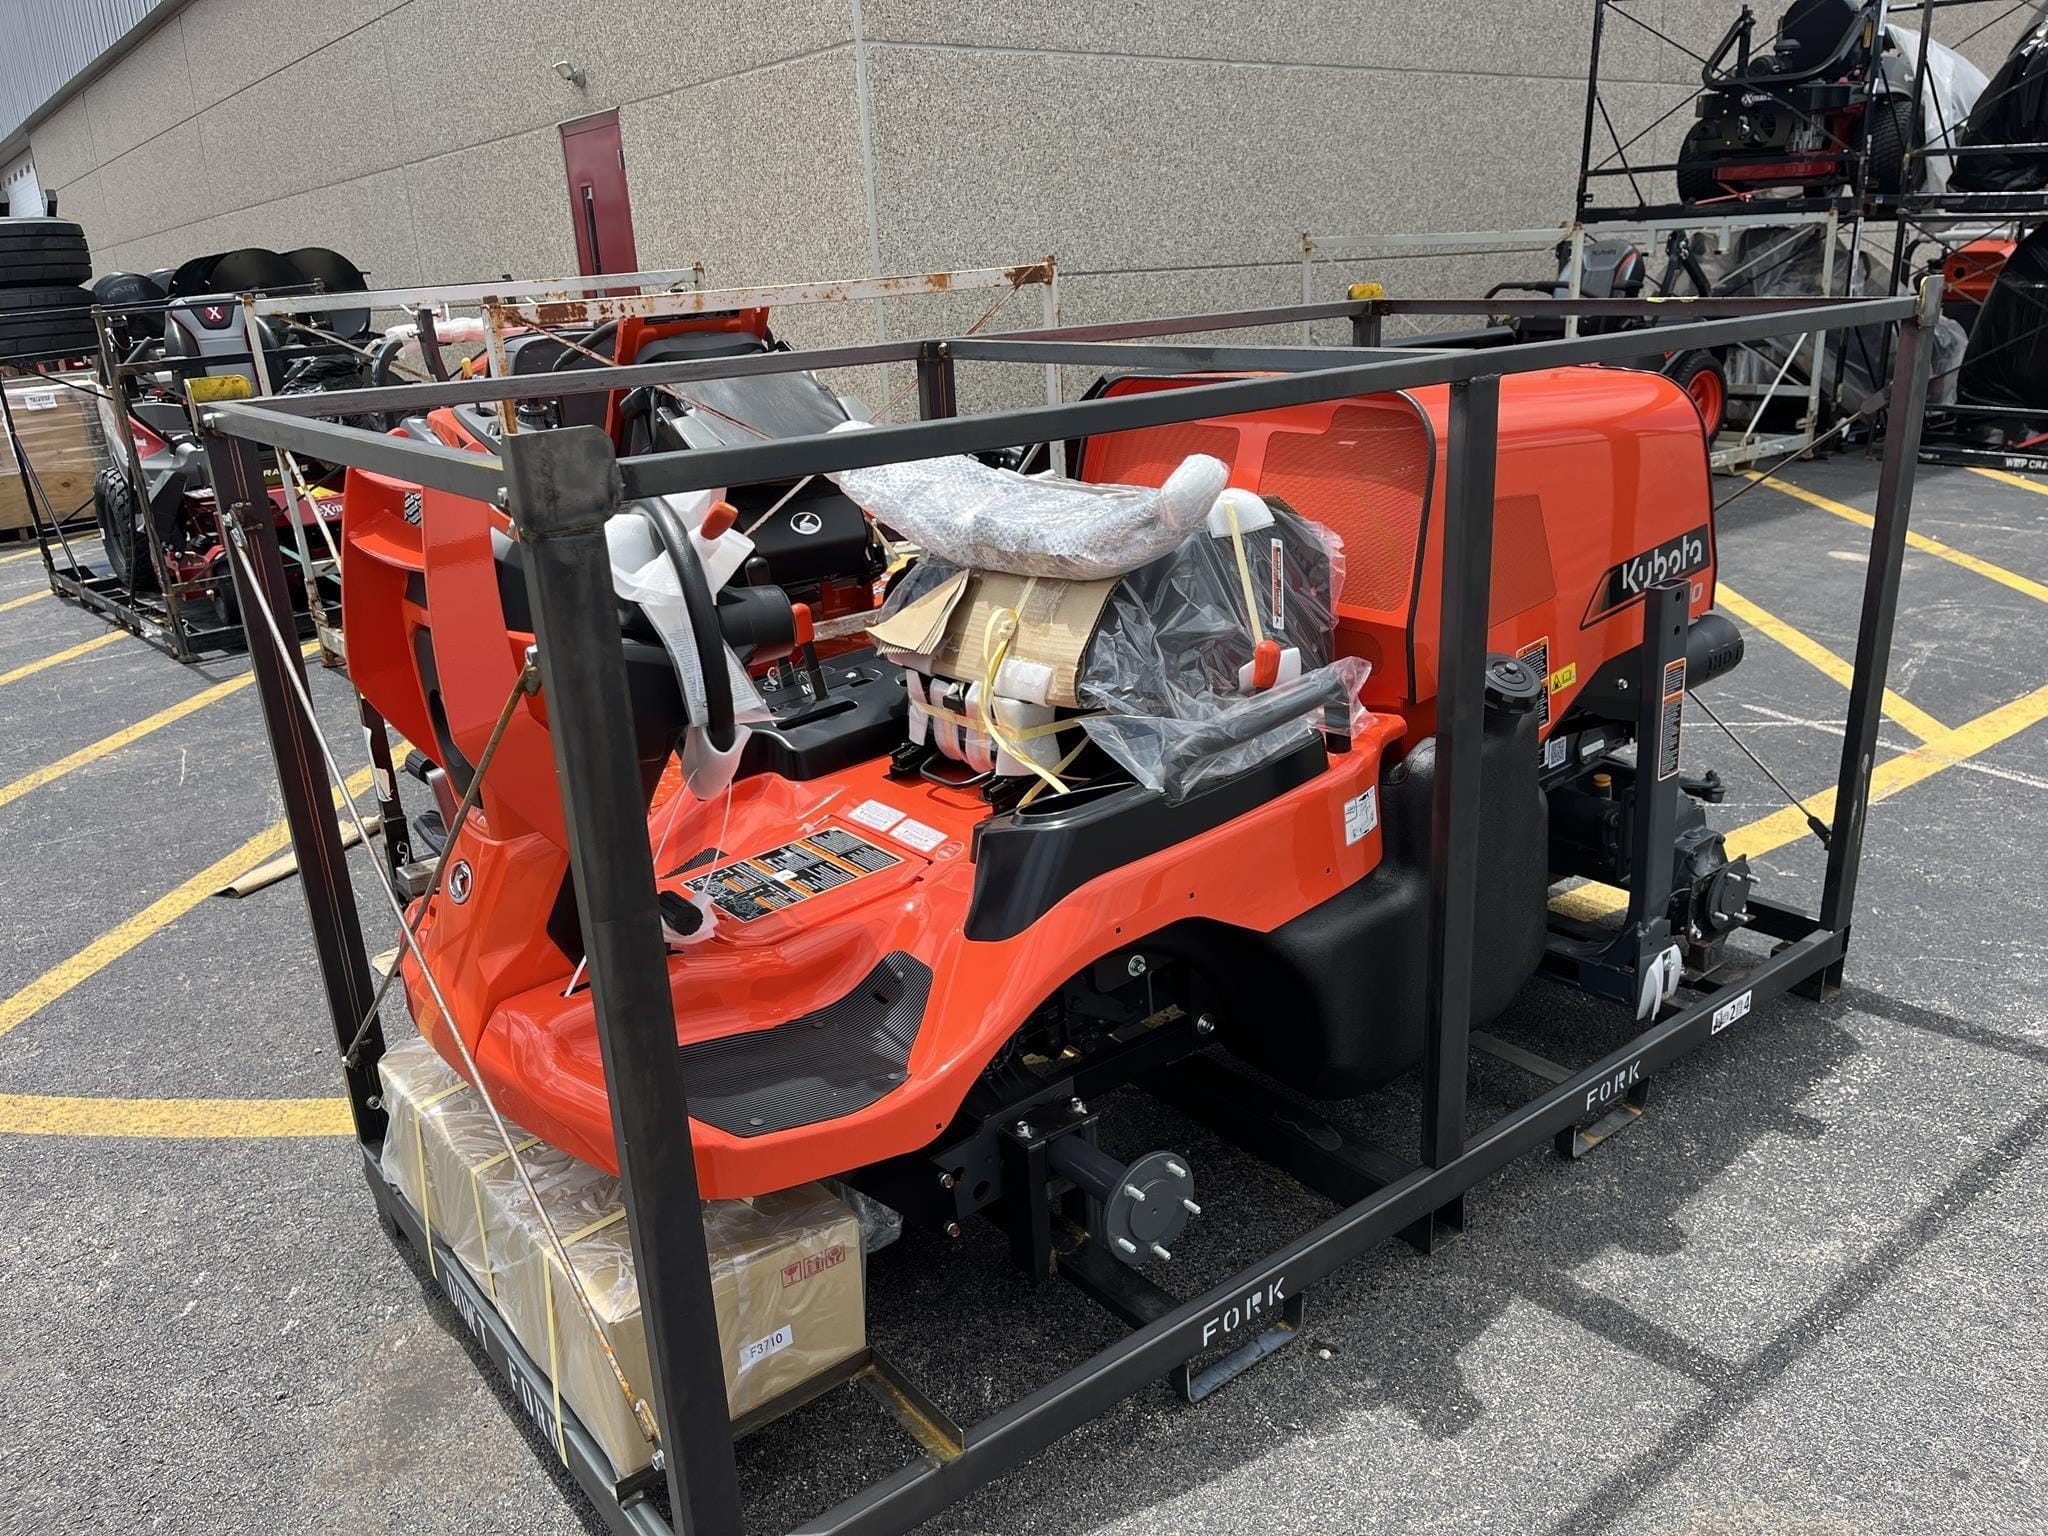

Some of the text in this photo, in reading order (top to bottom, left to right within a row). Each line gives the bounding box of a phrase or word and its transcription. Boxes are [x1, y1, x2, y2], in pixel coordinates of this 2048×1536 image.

[1622, 535, 1703, 593] Kubota
[1585, 1060, 1641, 1111] FORK
[1203, 1276, 1285, 1347] FORK
[750, 1333, 783, 1358] F3710
